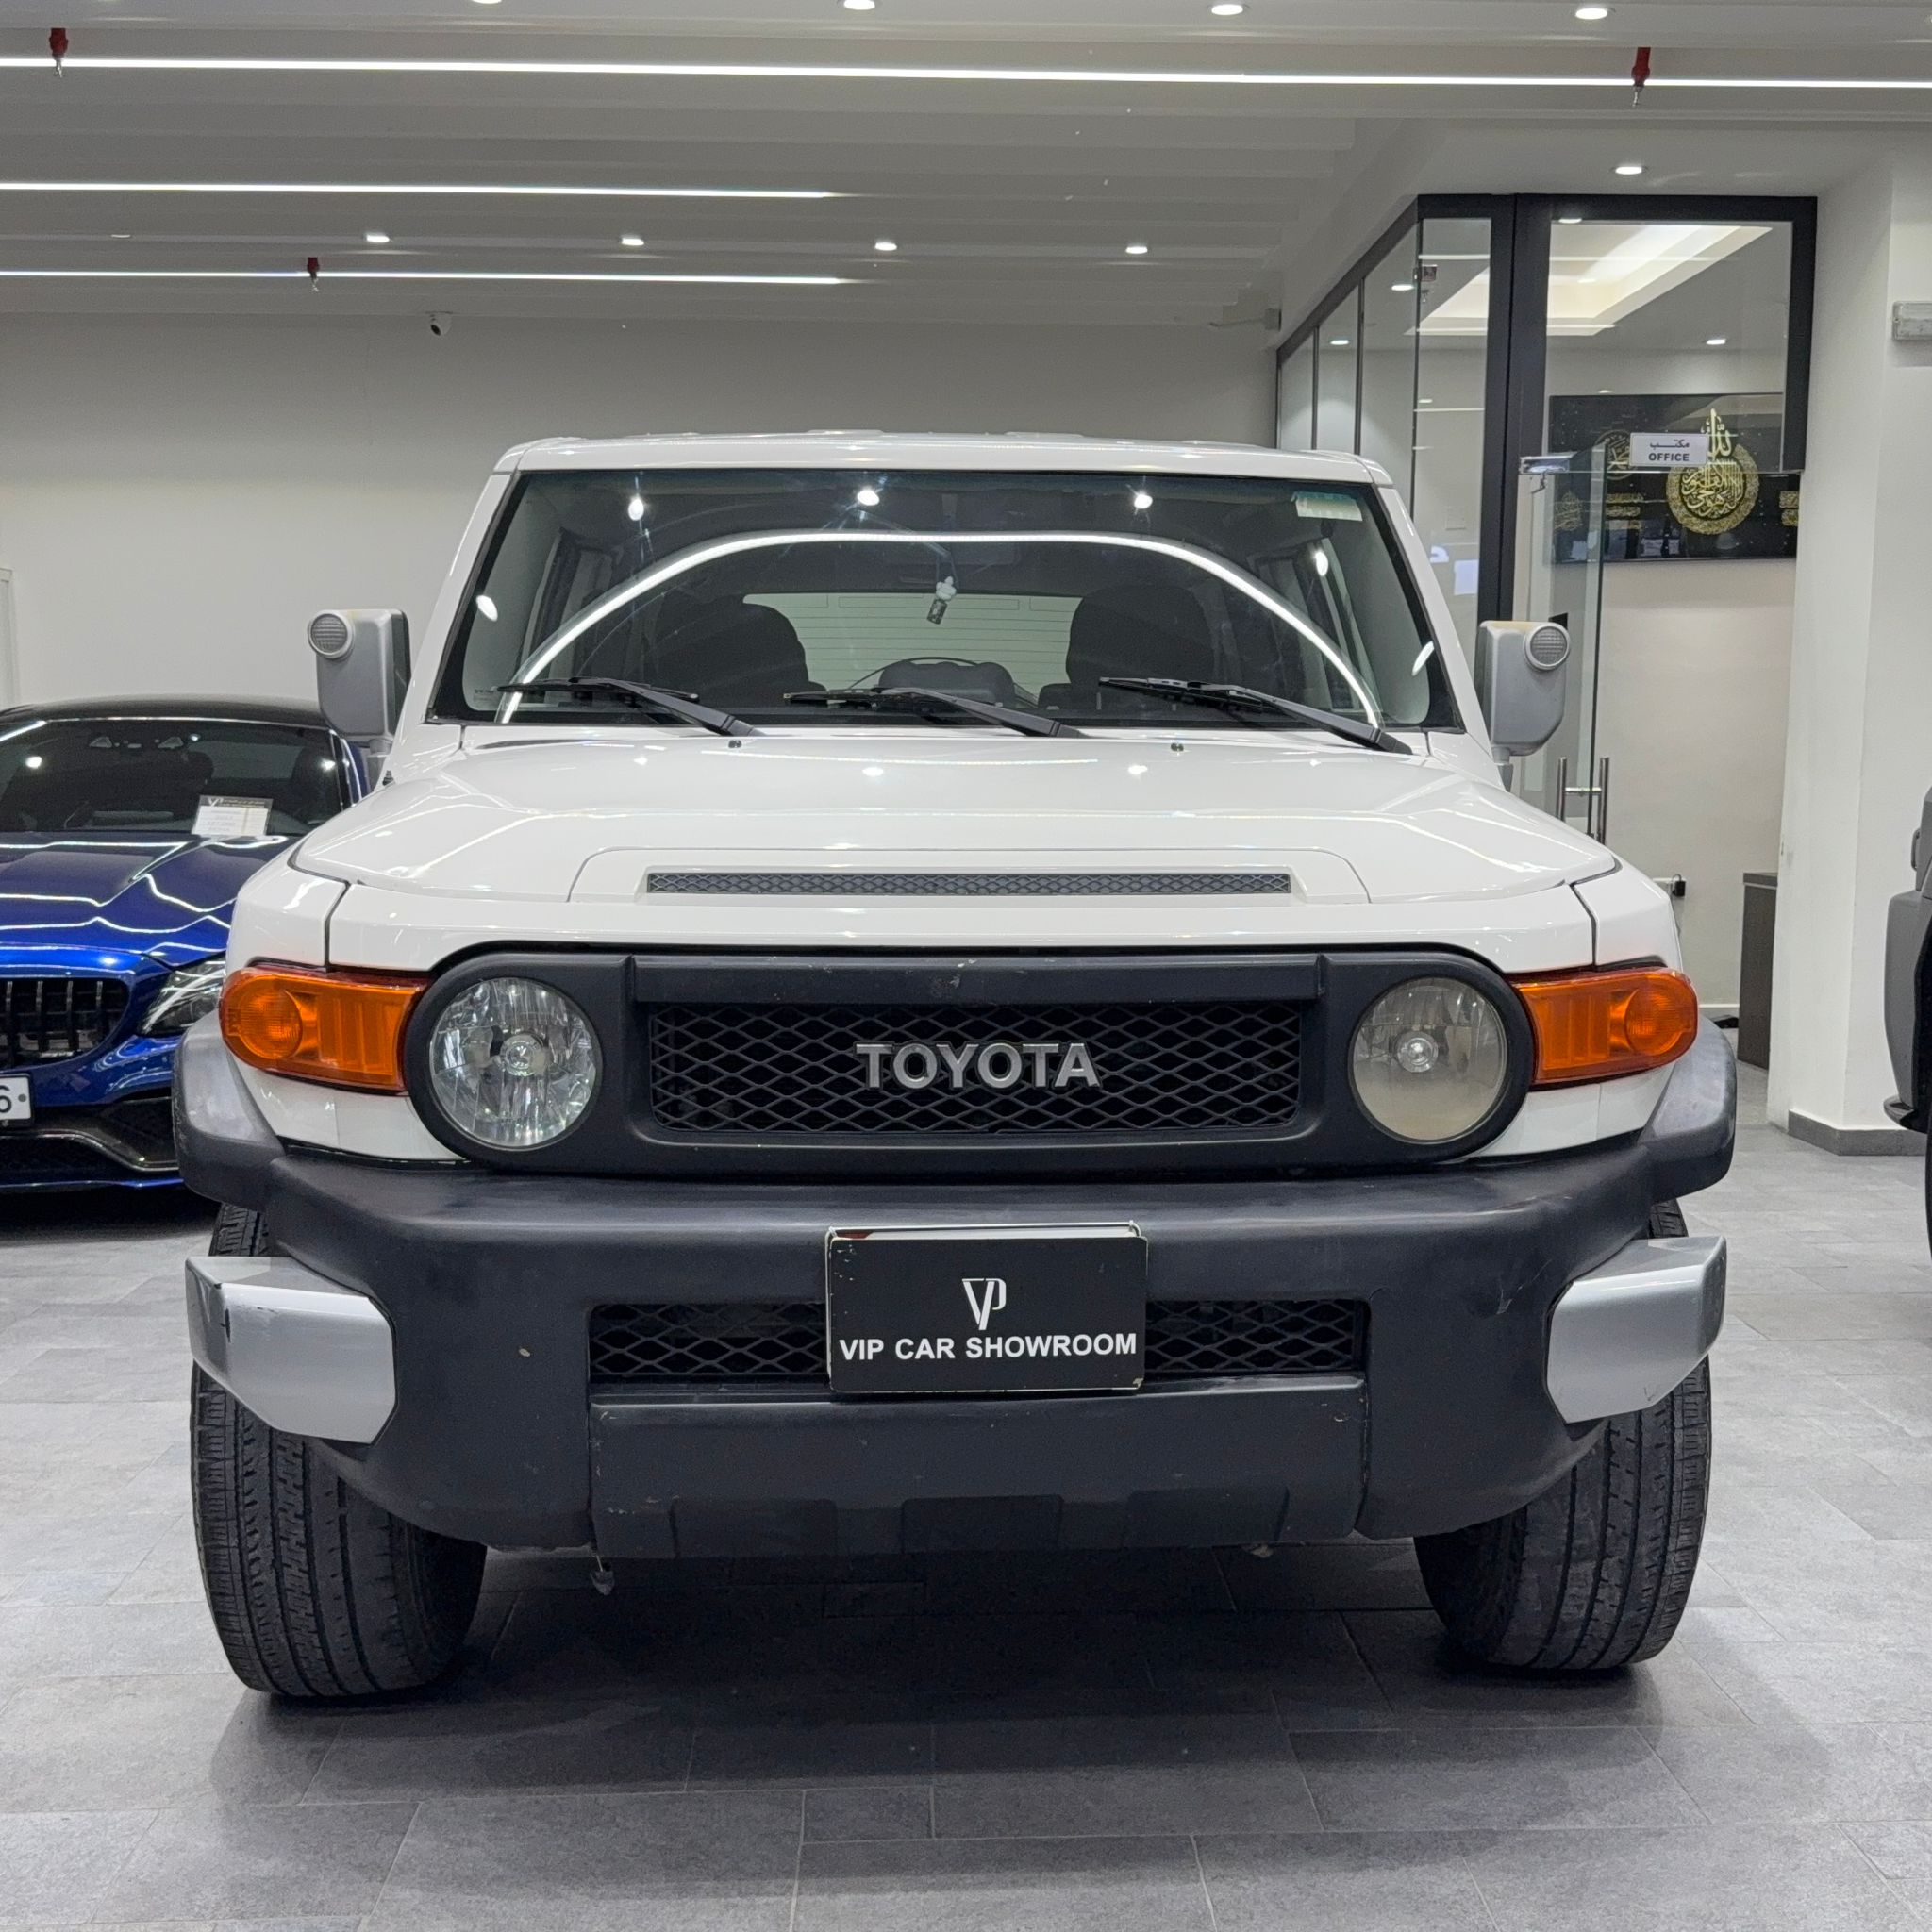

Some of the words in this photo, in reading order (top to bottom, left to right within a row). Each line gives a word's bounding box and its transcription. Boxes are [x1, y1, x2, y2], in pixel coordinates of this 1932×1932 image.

[1649, 439, 1690, 450] مكتب
[1648, 453, 1690, 461] OFFICE
[855, 1042, 1101, 1089] TOYOTA
[839, 1338, 885, 1361] VIP
[895, 1337, 956, 1360] CAR
[965, 1332, 1137, 1359] SHOWROOM
